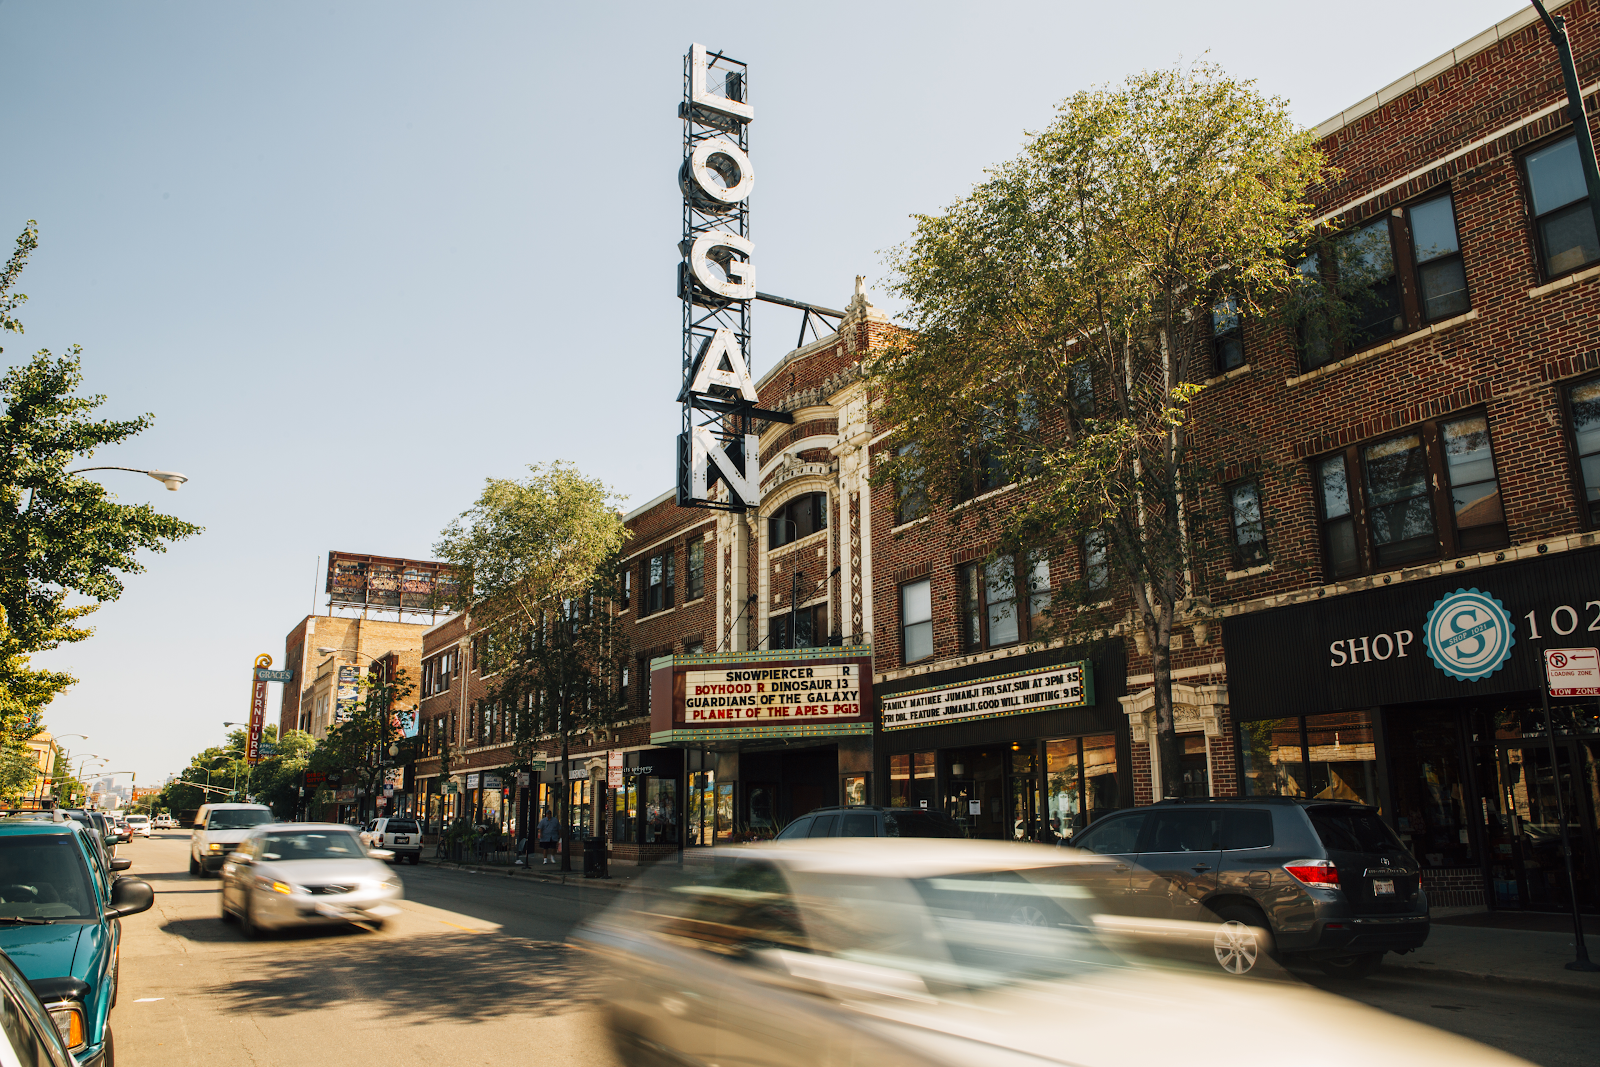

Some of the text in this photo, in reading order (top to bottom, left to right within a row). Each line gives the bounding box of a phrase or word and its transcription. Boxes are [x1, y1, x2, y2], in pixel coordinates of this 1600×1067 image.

[692, 42, 760, 507] LOGAN
[1448, 623, 1487, 645] SHOP 1021
[1329, 629, 1414, 667] SHOP
[258, 670, 291, 680] GRACE'S
[726, 666, 850, 682] SNOWPIERCER R
[695, 678, 849, 696] BOYHOOD R DINOSAUR 13
[883, 700, 907, 711] FAMILY
[910, 695, 942, 707] MATINEE
[945, 689, 979, 702] JUMANJI
[1032, 678, 1043, 689] AT
[1045, 674, 1064, 687] 3PM
[1067, 672, 1079, 682] $5
[1575, 687, 1599, 695] ZONE
[686, 690, 859, 709] GUARDIANS OF THE GALAXY
[884, 714, 895, 723] FRI
[896, 712, 908, 722] DBL
[910, 707, 940, 720] FEATURE
[1001, 696, 1020, 707] WILL
[1023, 690, 1060, 704] HUNTING
[250, 682, 264, 758] FURNITURE
[692, 703, 859, 720] PLANET OF THE APES PG13
